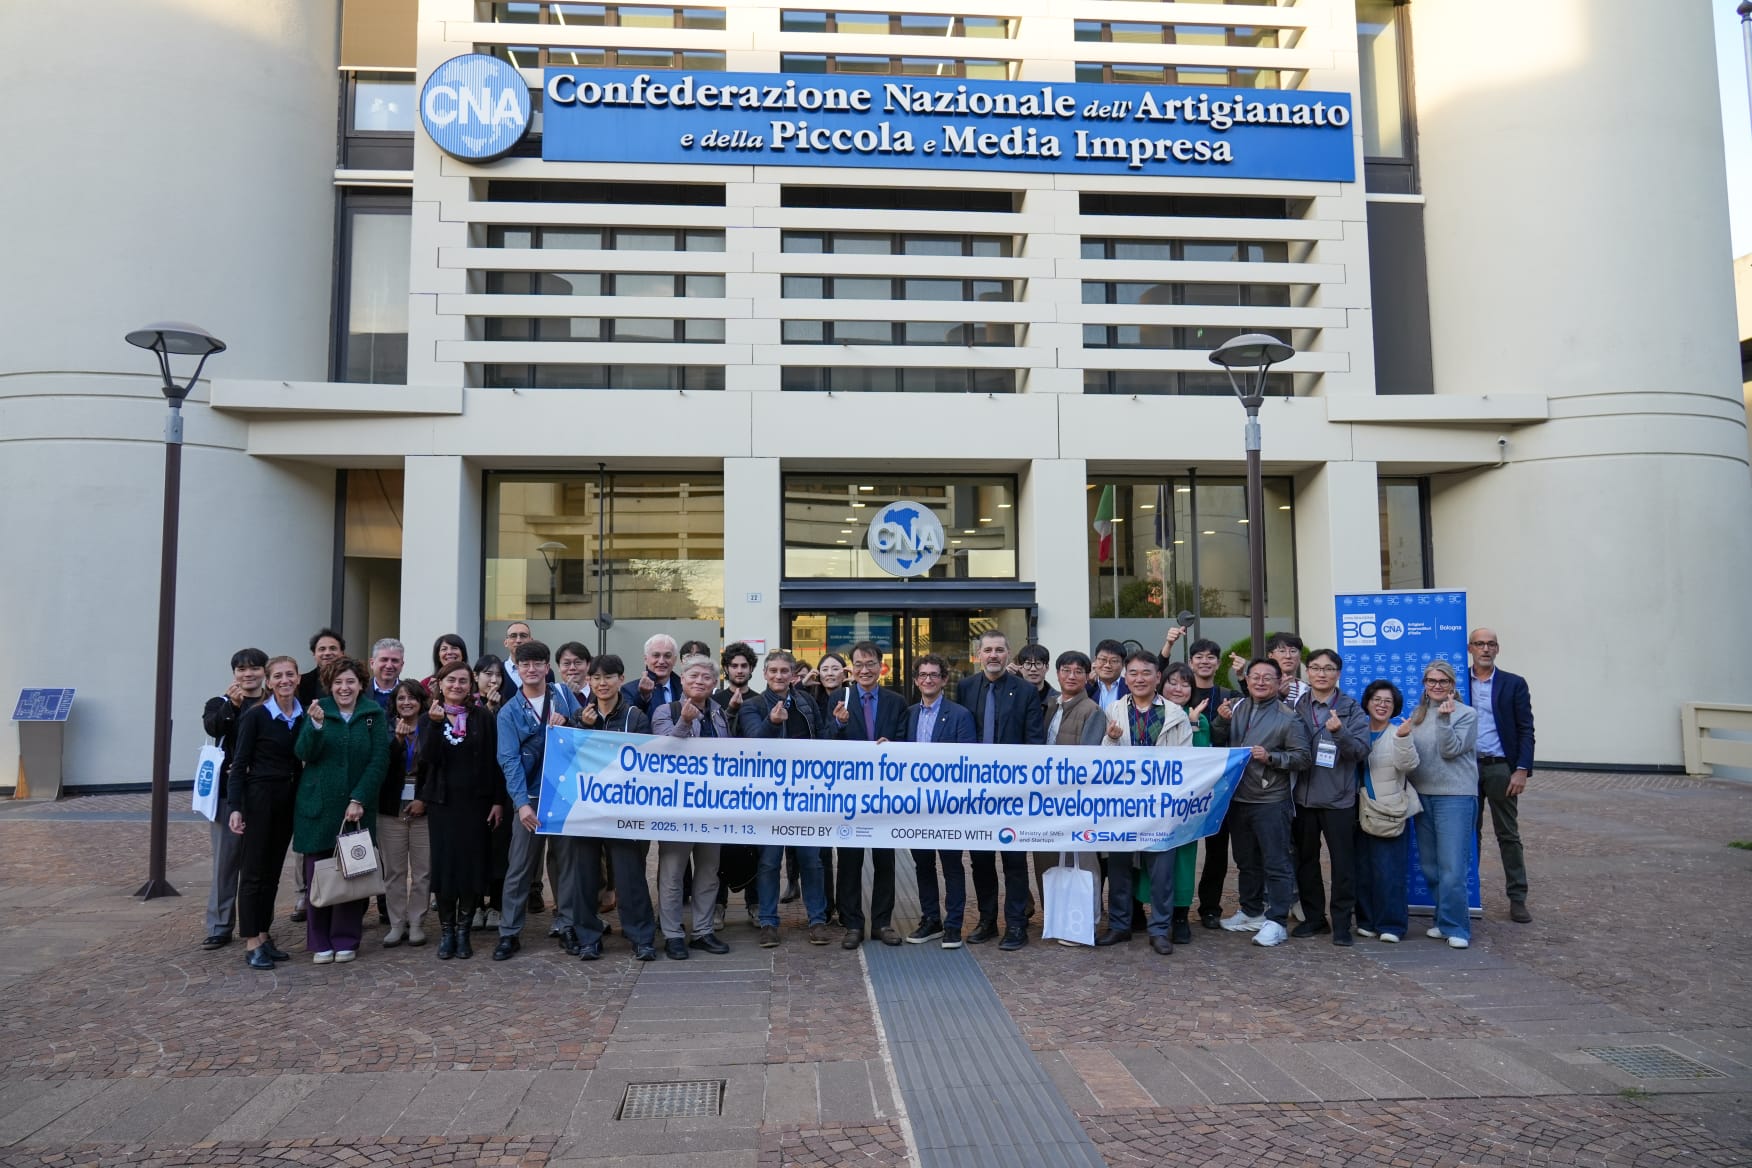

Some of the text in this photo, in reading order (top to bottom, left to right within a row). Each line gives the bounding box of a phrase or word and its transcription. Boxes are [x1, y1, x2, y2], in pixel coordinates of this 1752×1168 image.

[425, 85, 525, 126] CNA
[547, 74, 871, 111] Confederazione
[883, 84, 1076, 117] Nazionale
[1135, 91, 1350, 130] Artigianato
[680, 120, 1234, 168] e della Piccola e Media Impresa
[874, 526, 943, 550] CNA
[1383, 625, 1402, 633] CNA
[620, 745, 1184, 788] Overseas training program for coordinators of the 2025 SMB
[579, 775, 1213, 825] Vocational Education training school Workforce Development Project
[617, 819, 646, 830] DATE
[650, 821, 679, 833] 2025.
[682, 823, 698, 833] 11.
[701, 824, 710, 833] 5.
[723, 824, 738, 834] 11.
[741, 825, 756, 835] 13.
[771, 825, 832, 837] HOSTED BY
[891, 828, 993, 841] COOPERATED WITH
[1072, 829, 1137, 844] KOSME
